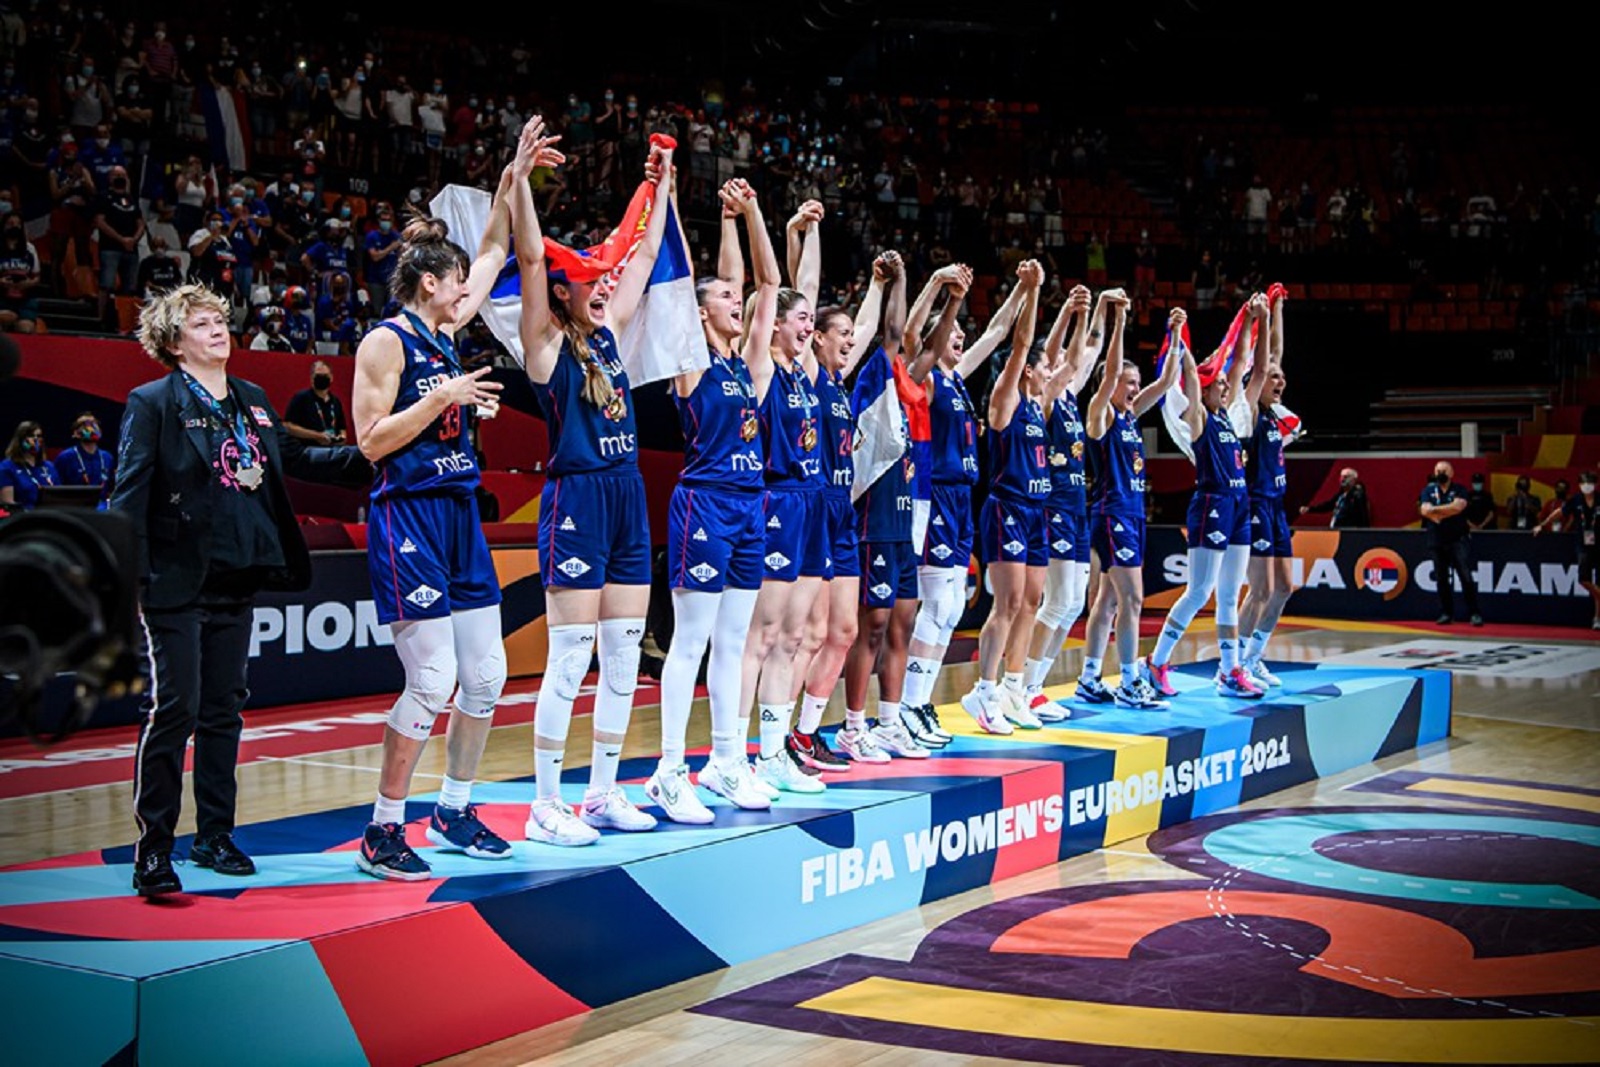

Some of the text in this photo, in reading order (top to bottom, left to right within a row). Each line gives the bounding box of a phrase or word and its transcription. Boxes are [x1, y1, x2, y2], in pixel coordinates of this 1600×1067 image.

[599, 431, 635, 457] mts
[433, 449, 475, 476] mts
[1414, 559, 1596, 597] CHAM
[801, 735, 1291, 904] FIBA WOMEN'S EUROBASKET 2021
